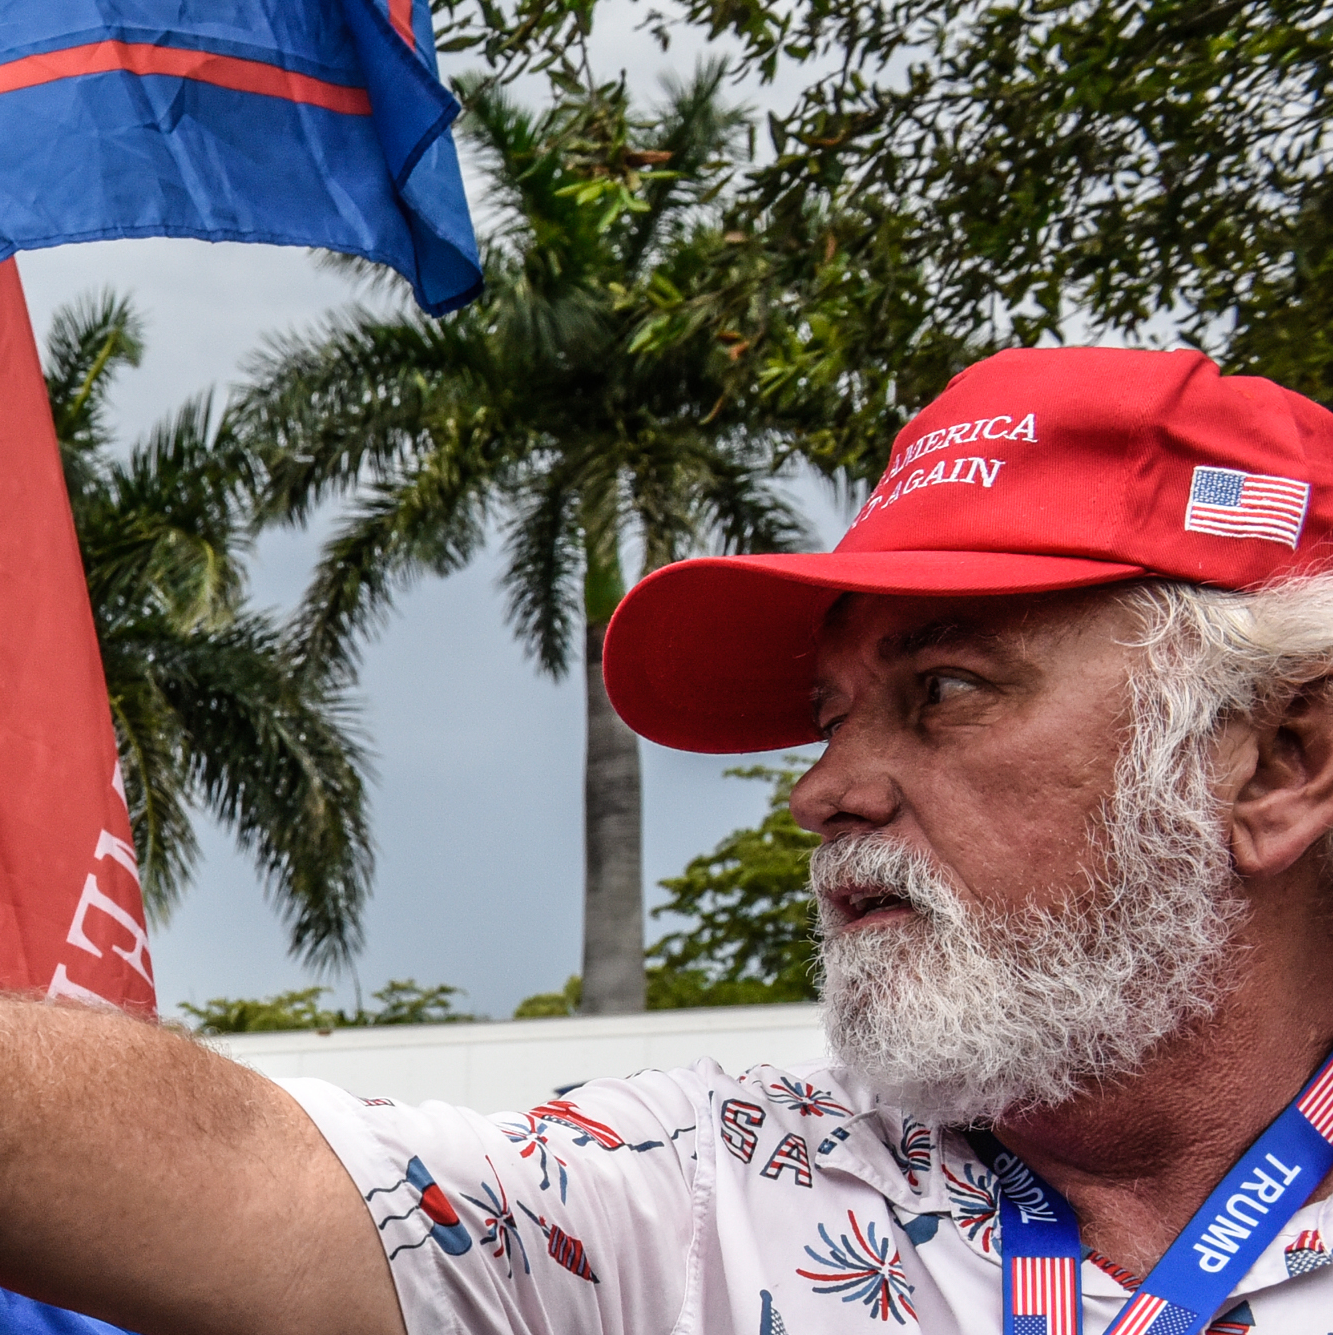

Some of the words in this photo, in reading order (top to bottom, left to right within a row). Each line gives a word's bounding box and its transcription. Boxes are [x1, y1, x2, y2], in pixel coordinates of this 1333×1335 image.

[889, 413, 1039, 478] AMERICA
[881, 457, 1006, 510] AGAIN
[719, 1098, 813, 1188] SA
[994, 1151, 1058, 1224] TRUMP
[1192, 1152, 1302, 1273] TRUMP
